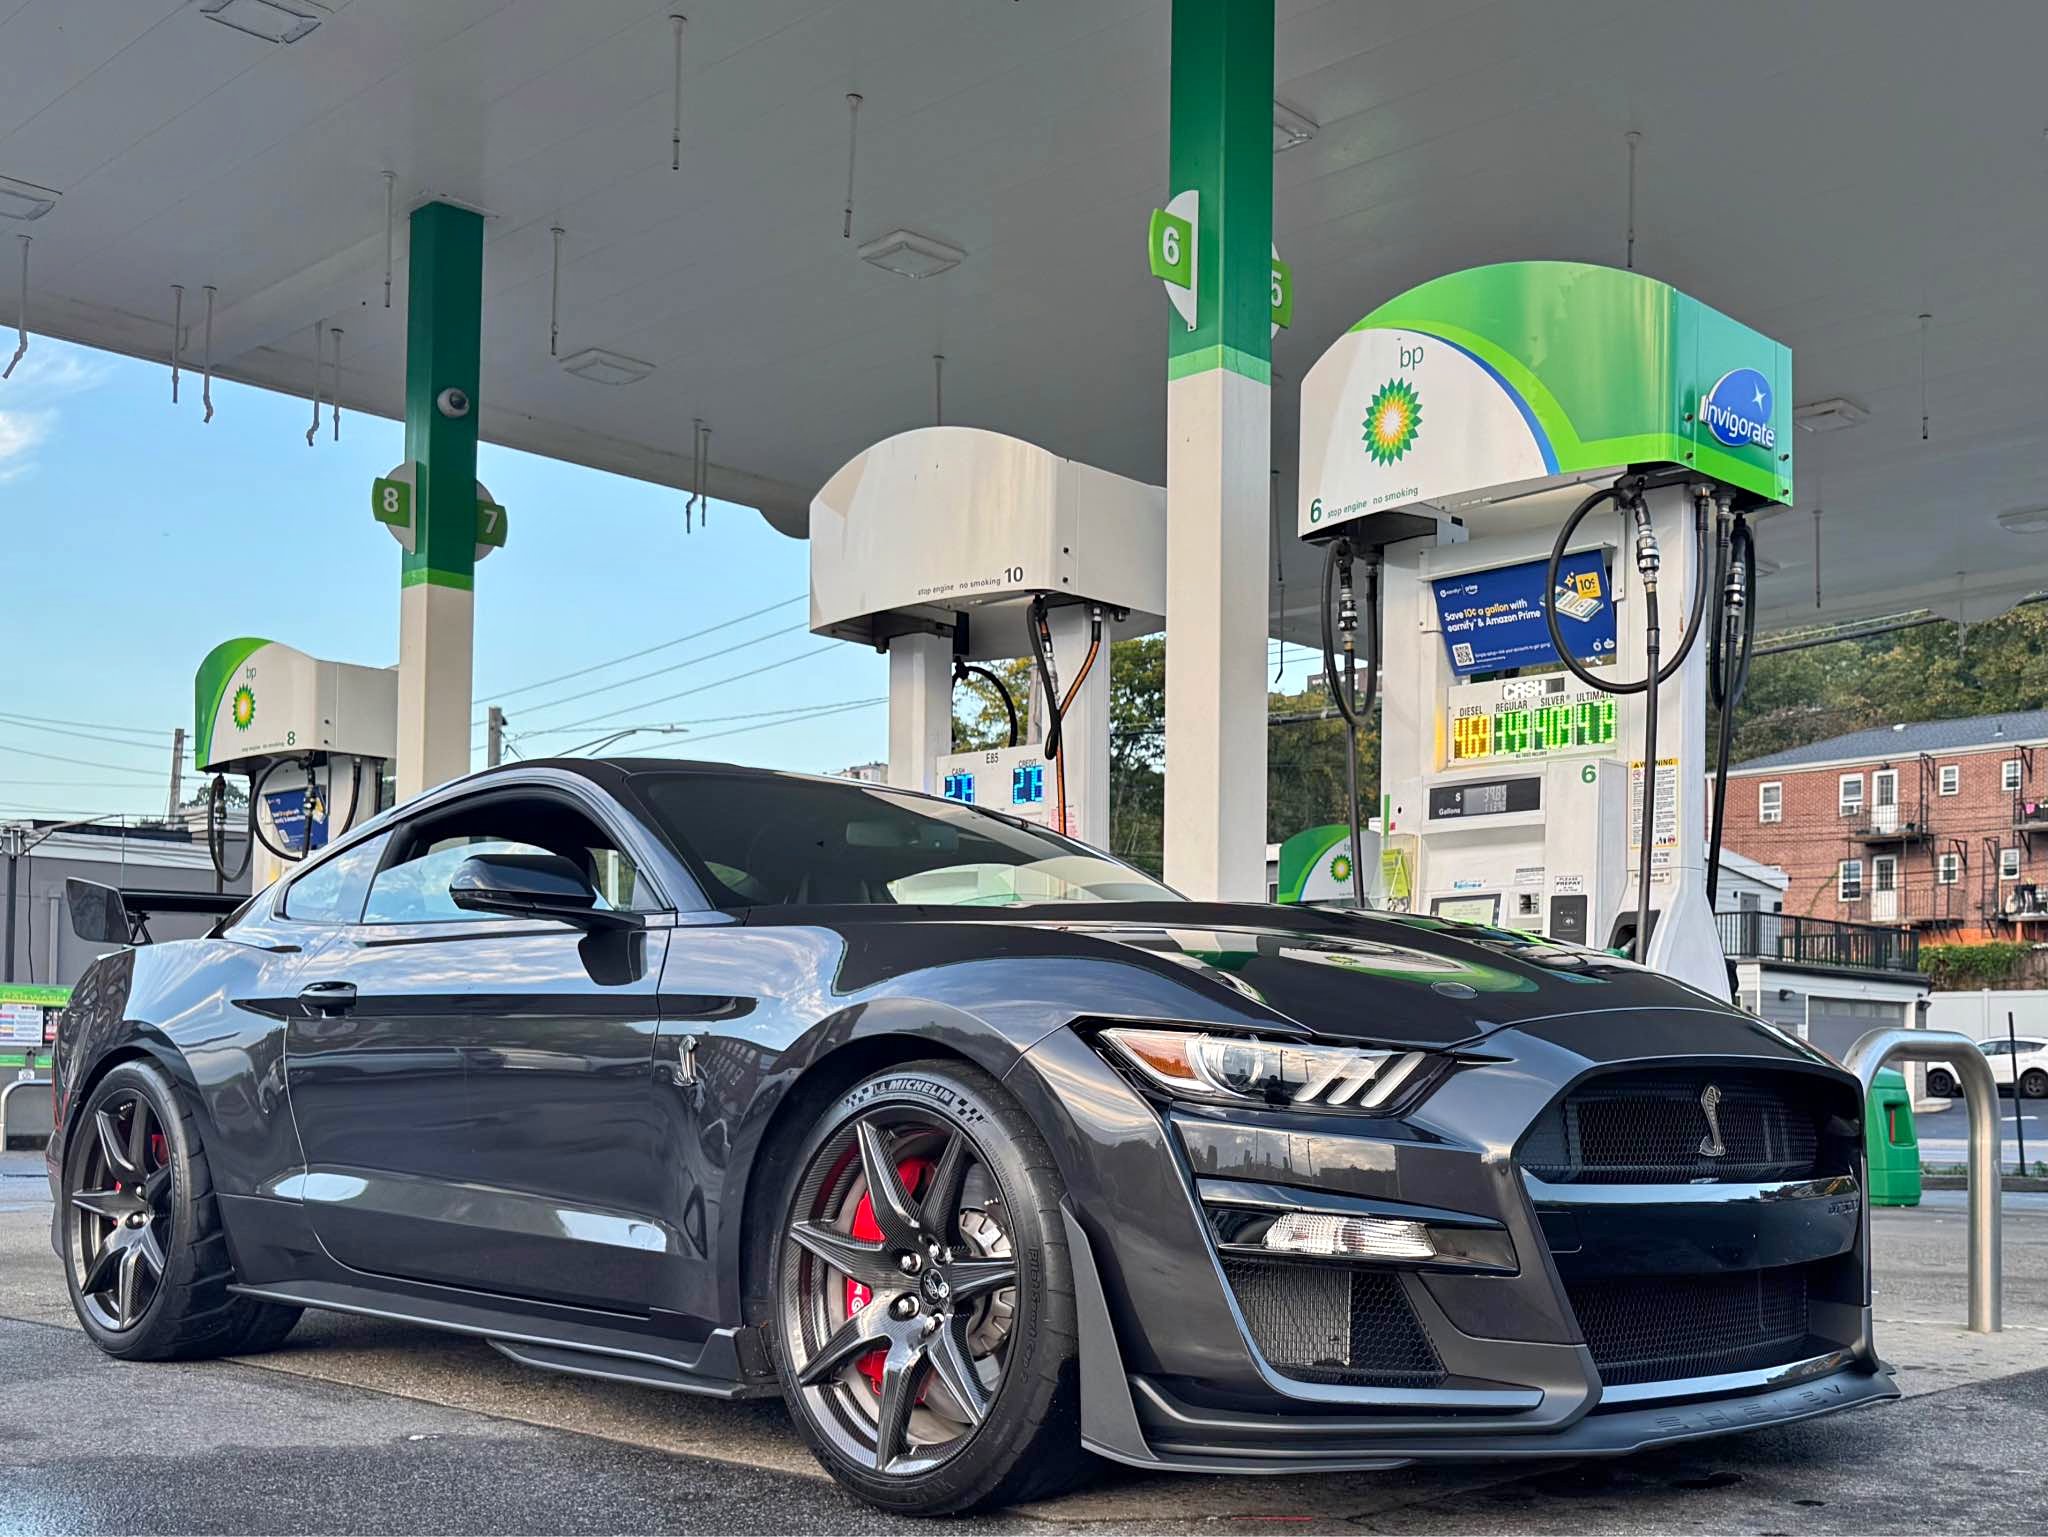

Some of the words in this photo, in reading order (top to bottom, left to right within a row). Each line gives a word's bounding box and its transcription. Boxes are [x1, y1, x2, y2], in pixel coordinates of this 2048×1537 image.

[1163, 226, 1180, 265] 6
[1271, 270, 1282, 308] 5
[1400, 345, 1424, 371] bp
[1703, 396, 1775, 447] Invigorate
[383, 487, 399, 513] 8
[1310, 498, 1322, 523] 6
[1327, 507, 1342, 518] stop
[1343, 501, 1367, 513] engine
[1373, 496, 1383, 505] no
[1384, 487, 1418, 500] smoking
[483, 509, 498, 534] 7
[933, 584, 954, 593] engine
[970, 578, 1001, 588] smoking
[1004, 566, 1023, 583] 10
[1444, 611, 1464, 621] Save
[1484, 602, 1509, 616] gallon
[1509, 598, 1528, 609] with
[1478, 619, 1484, 627] &
[1486, 616, 1518, 626] Amazon
[1518, 610, 1541, 620] Prime
[246, 666, 257, 680] bp
[1503, 680, 1546, 700] CASH
[1459, 705, 1483, 717] DIESEL
[1495, 700, 1528, 712] REGULAR
[1576, 690, 1614, 702] ULTIMATE
[287, 731, 295, 746] 8
[986, 752, 999, 764] E85
[1019, 758, 1037, 768] CREDIT
[1581, 764, 1597, 784] 6
[1438, 807, 1461, 816] Gallons
[888, 1079, 955, 1104] MICHELIN
[1655, 1384, 1843, 1432] SHELBY
